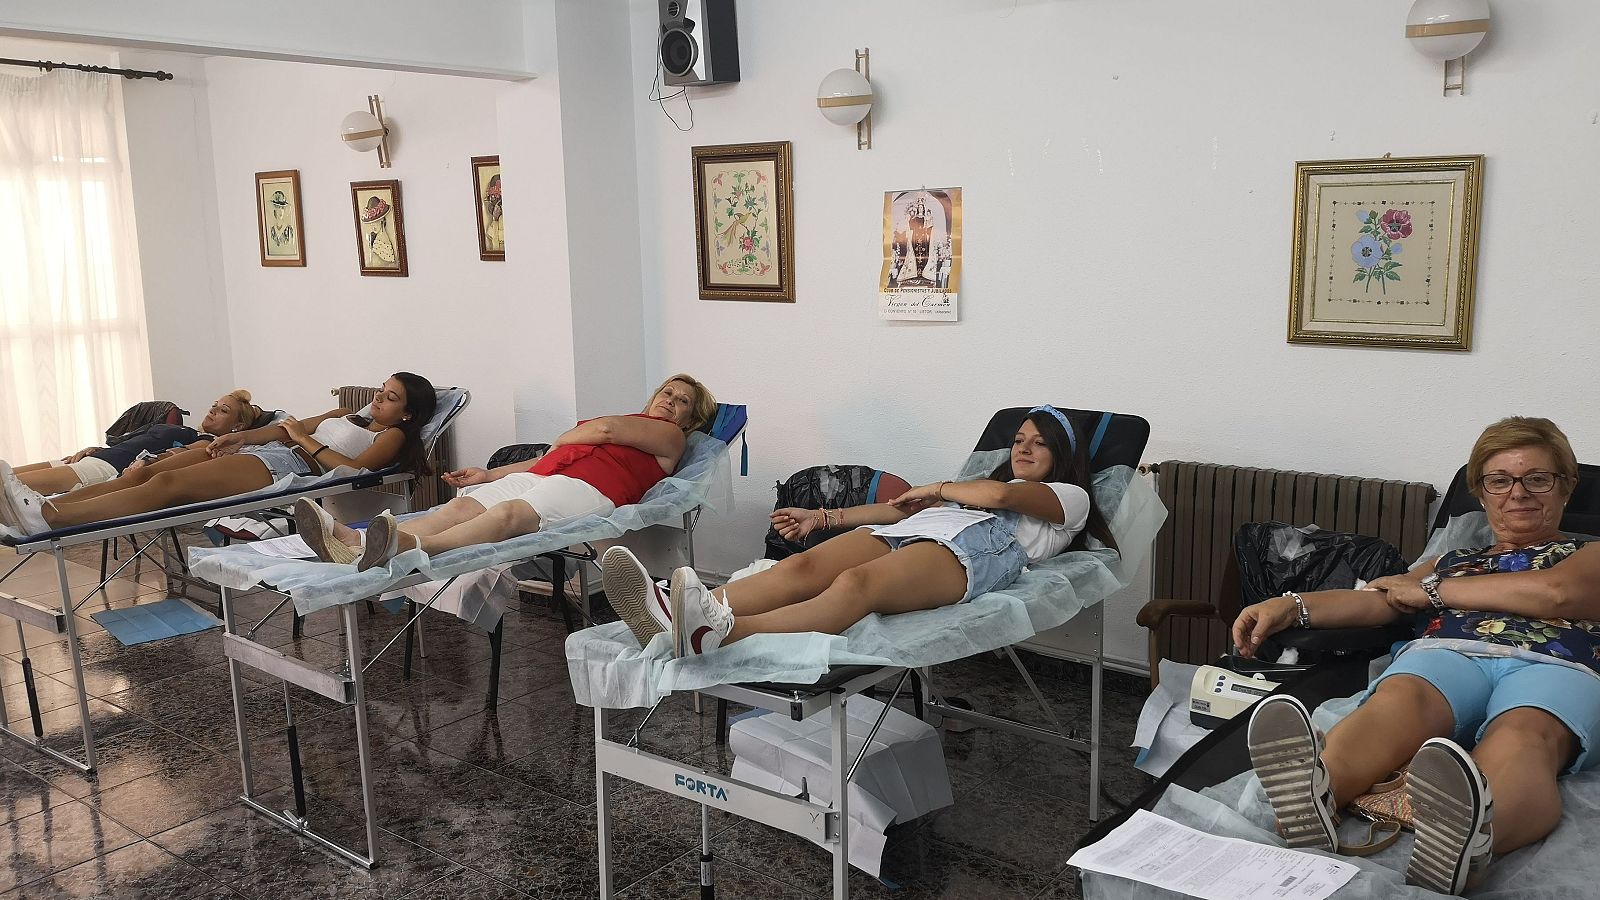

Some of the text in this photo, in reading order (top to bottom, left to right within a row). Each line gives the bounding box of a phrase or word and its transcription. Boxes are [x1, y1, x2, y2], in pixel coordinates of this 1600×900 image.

[885, 294, 908, 307] Virgen
[921, 294, 951, 307] Carmen
[674, 773, 728, 802] FORTA
